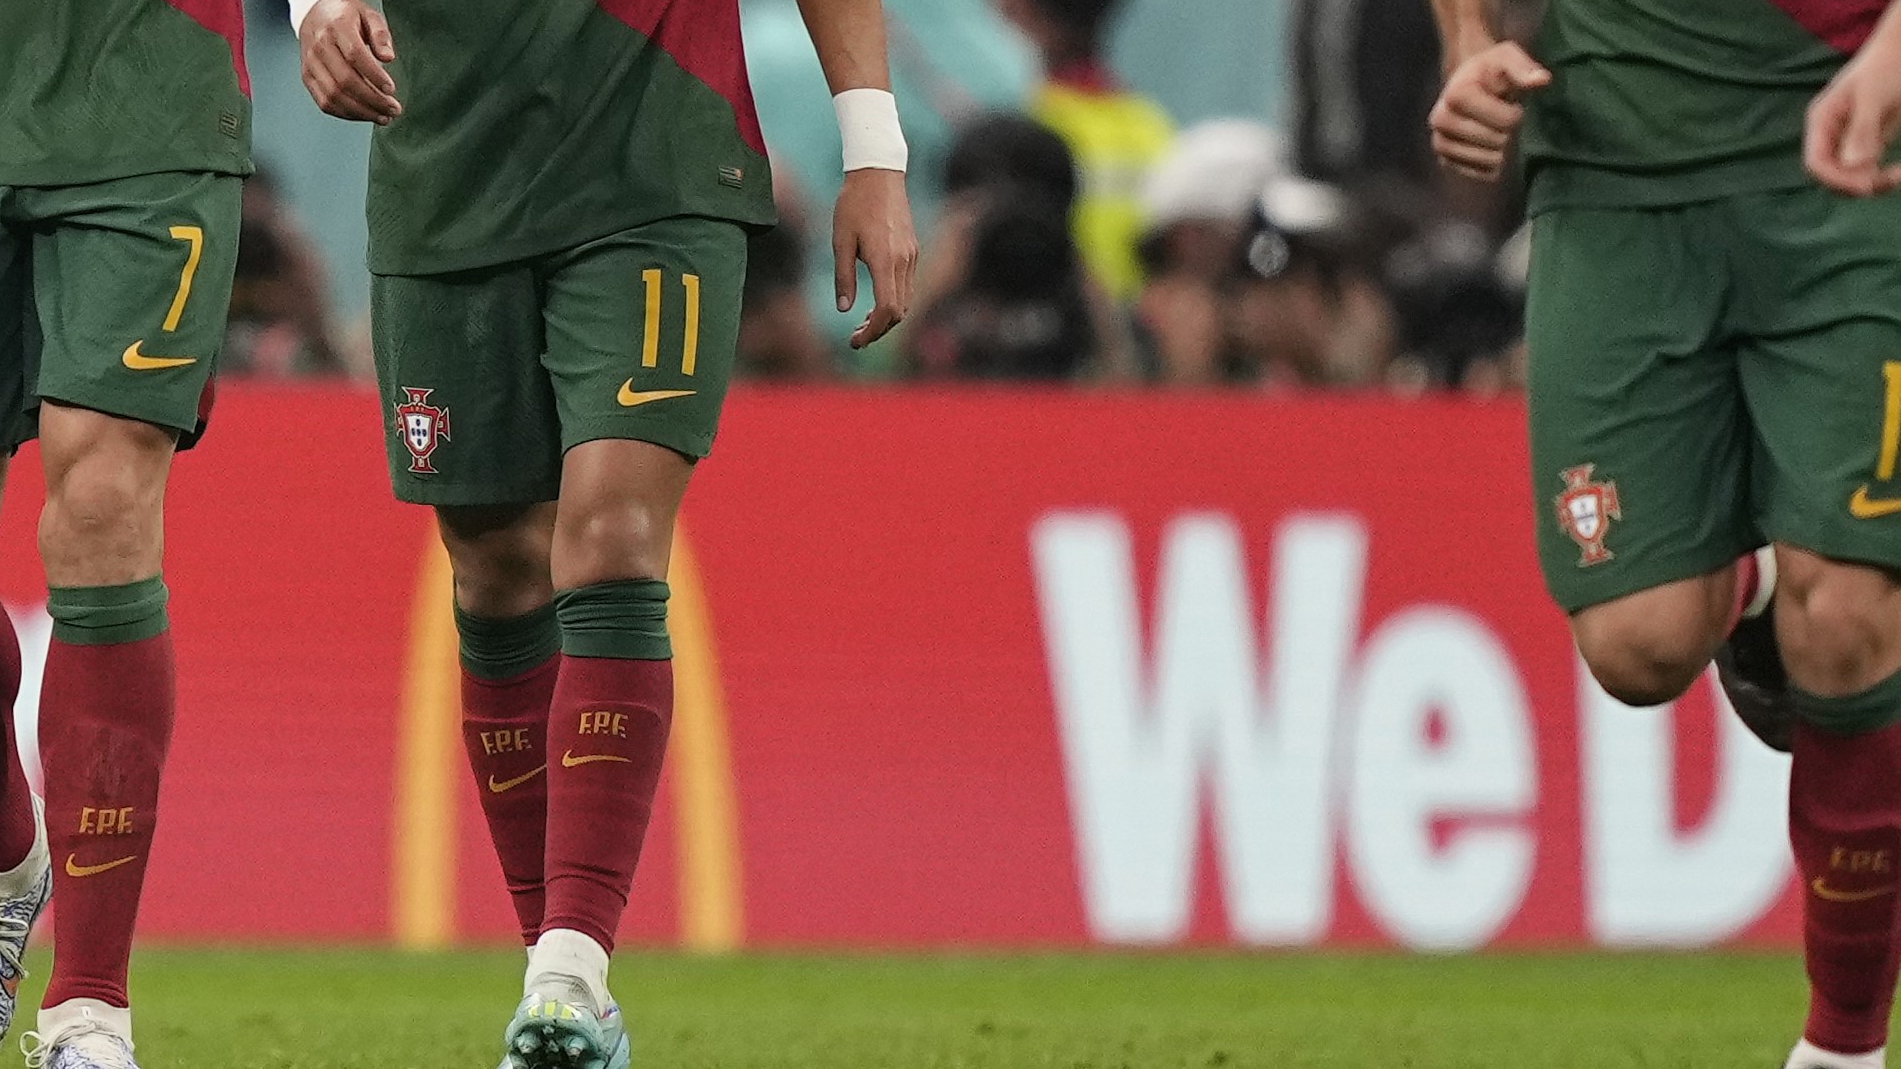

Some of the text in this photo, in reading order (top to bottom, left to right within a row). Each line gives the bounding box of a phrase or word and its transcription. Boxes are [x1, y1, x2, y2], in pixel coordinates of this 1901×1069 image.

[163, 226, 205, 333] 7
[642, 267, 701, 376] 11
[1033, 512, 1537, 950] We
